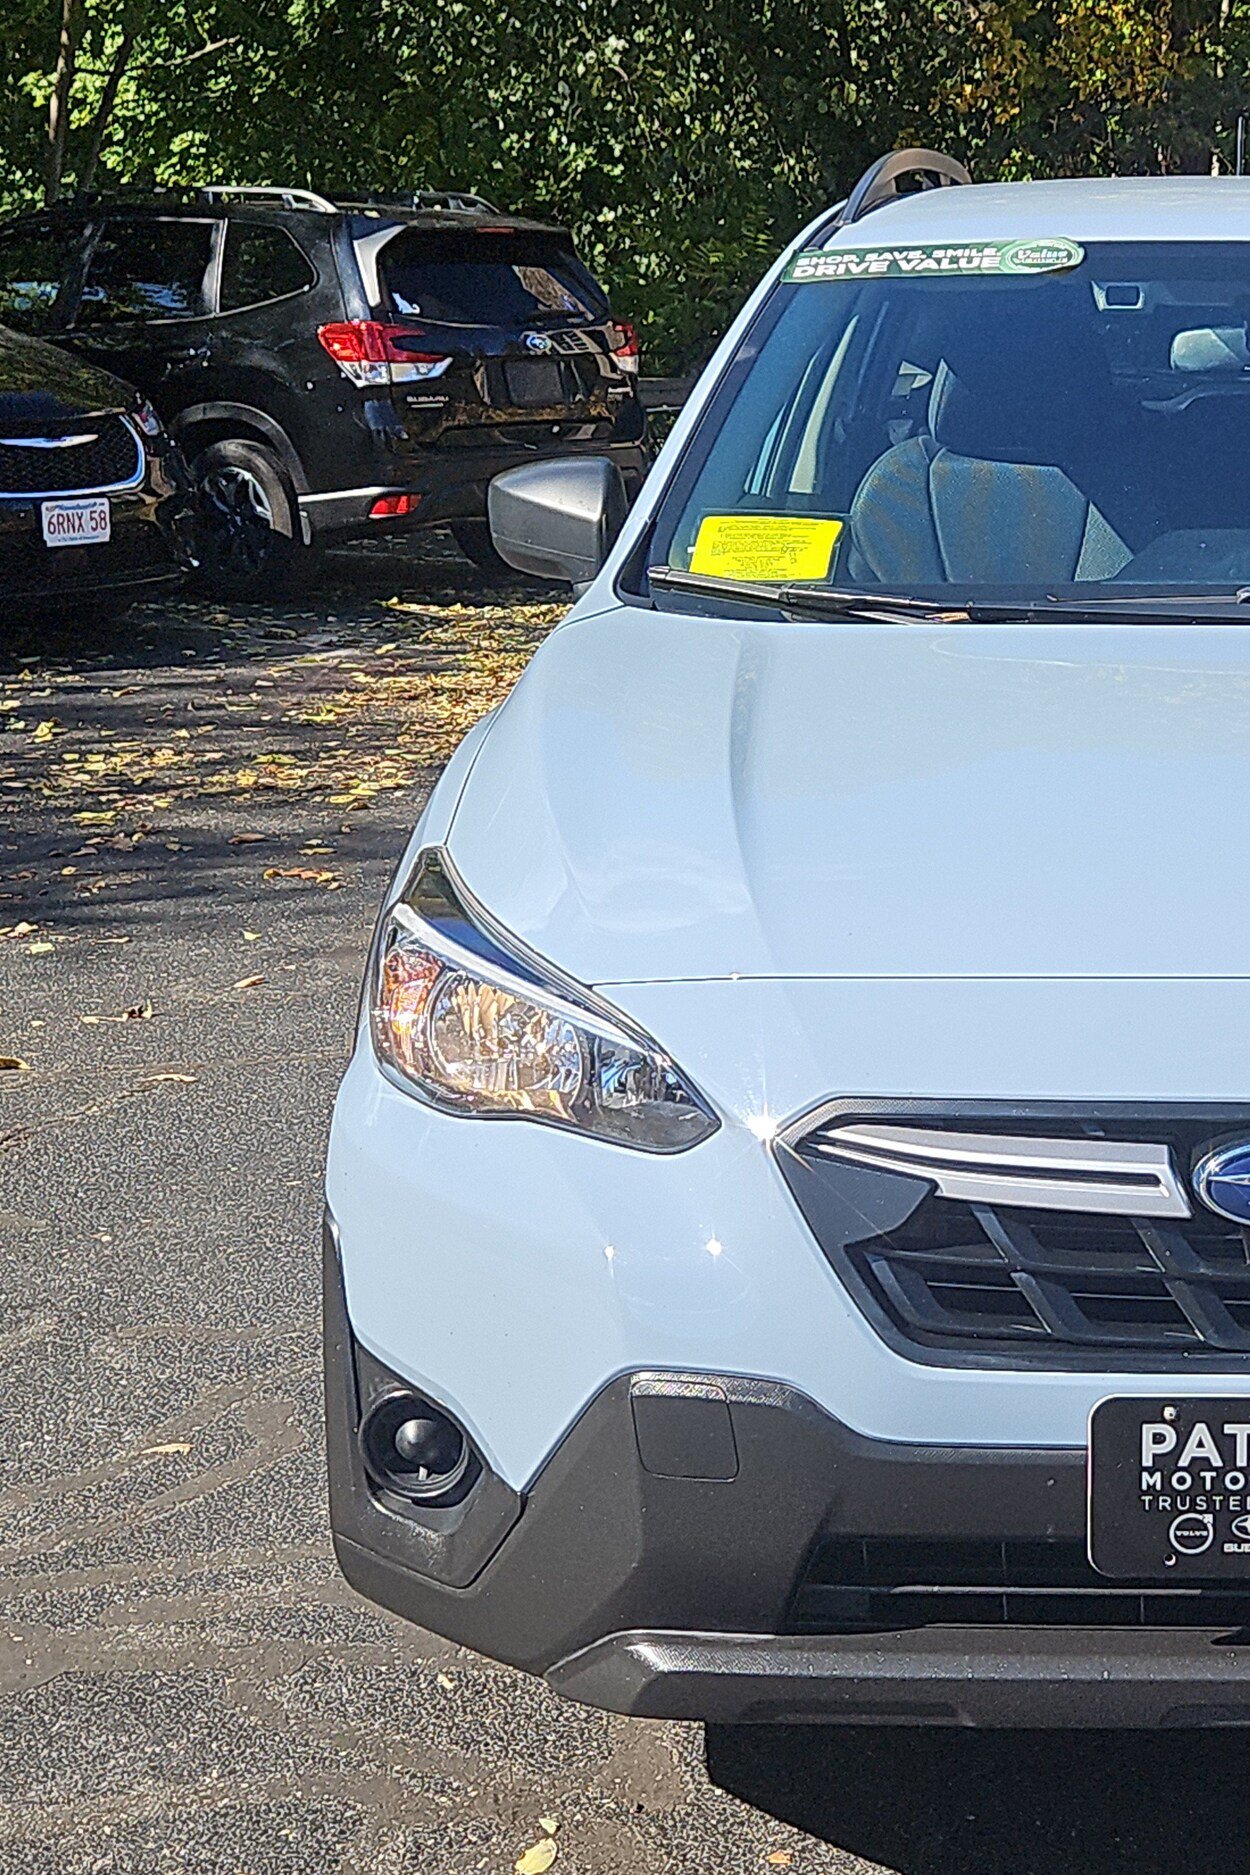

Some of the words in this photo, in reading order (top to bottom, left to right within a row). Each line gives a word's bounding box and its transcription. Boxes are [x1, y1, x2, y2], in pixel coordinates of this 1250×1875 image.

[1016, 248, 1069, 260] Value
[792, 260, 891, 278] DRIVE
[897, 256, 1002, 271] VALUE
[47, 511, 86, 535] 6RNX
[89, 509, 108, 532] 58
[1174, 1529, 1209, 1537] VOLVO
